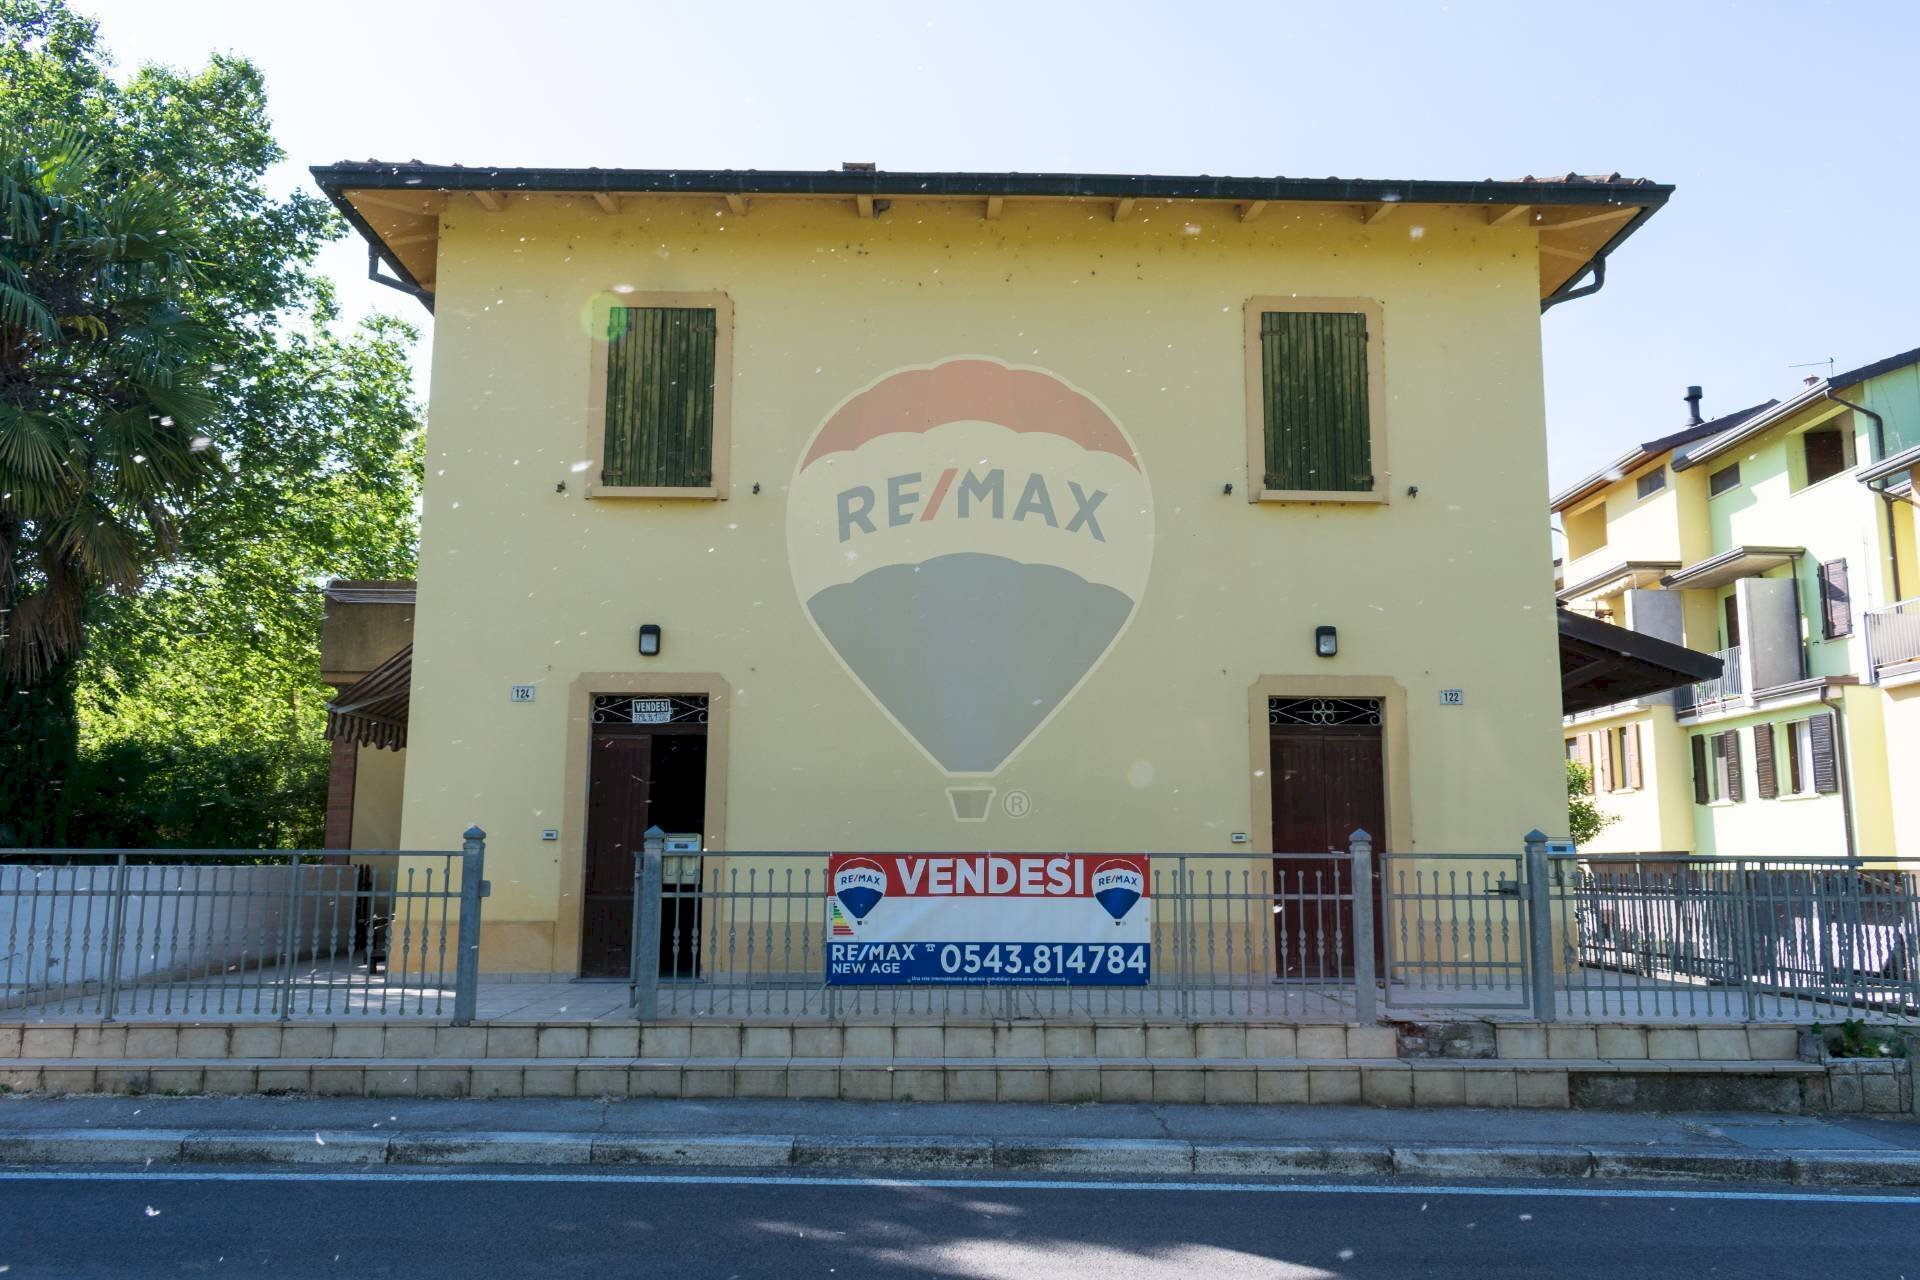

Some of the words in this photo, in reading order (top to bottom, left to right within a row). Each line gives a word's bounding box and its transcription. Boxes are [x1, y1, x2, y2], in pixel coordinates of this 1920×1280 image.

[516, 688, 530, 698] 124
[1444, 692, 1459, 702] 122
[635, 702, 668, 712] VENDESI
[841, 874, 880, 885] RE/MAX
[895, 858, 1084, 895] VENDESI
[1098, 875, 1137, 886] RE/MAX
[832, 944, 915, 961] RE/MAX
[940, 944, 1147, 974] 0543.814784
[832, 963, 866, 974] NEW
[870, 963, 900, 974] AGE
